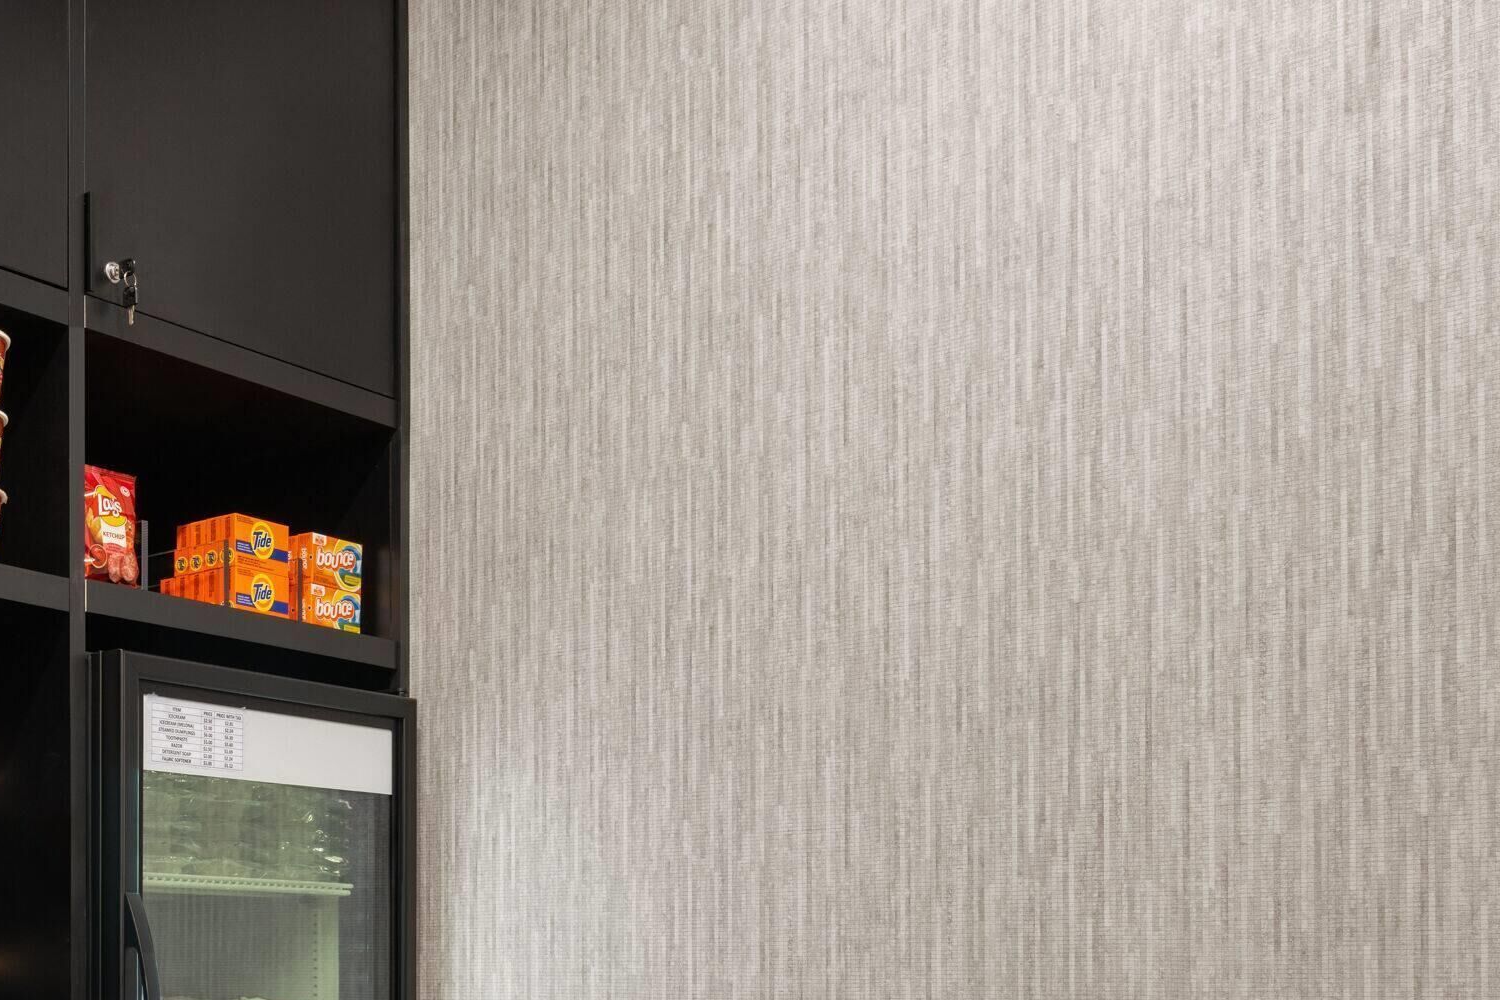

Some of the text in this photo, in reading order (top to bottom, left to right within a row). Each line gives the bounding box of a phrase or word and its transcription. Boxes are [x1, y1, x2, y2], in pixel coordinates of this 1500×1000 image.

[103, 531, 125, 540] KETCHUP
[253, 531, 272, 549] Tide
[316, 547, 355, 570] bounce
[253, 583, 272, 602] Tide
[315, 597, 355, 620] bounce
